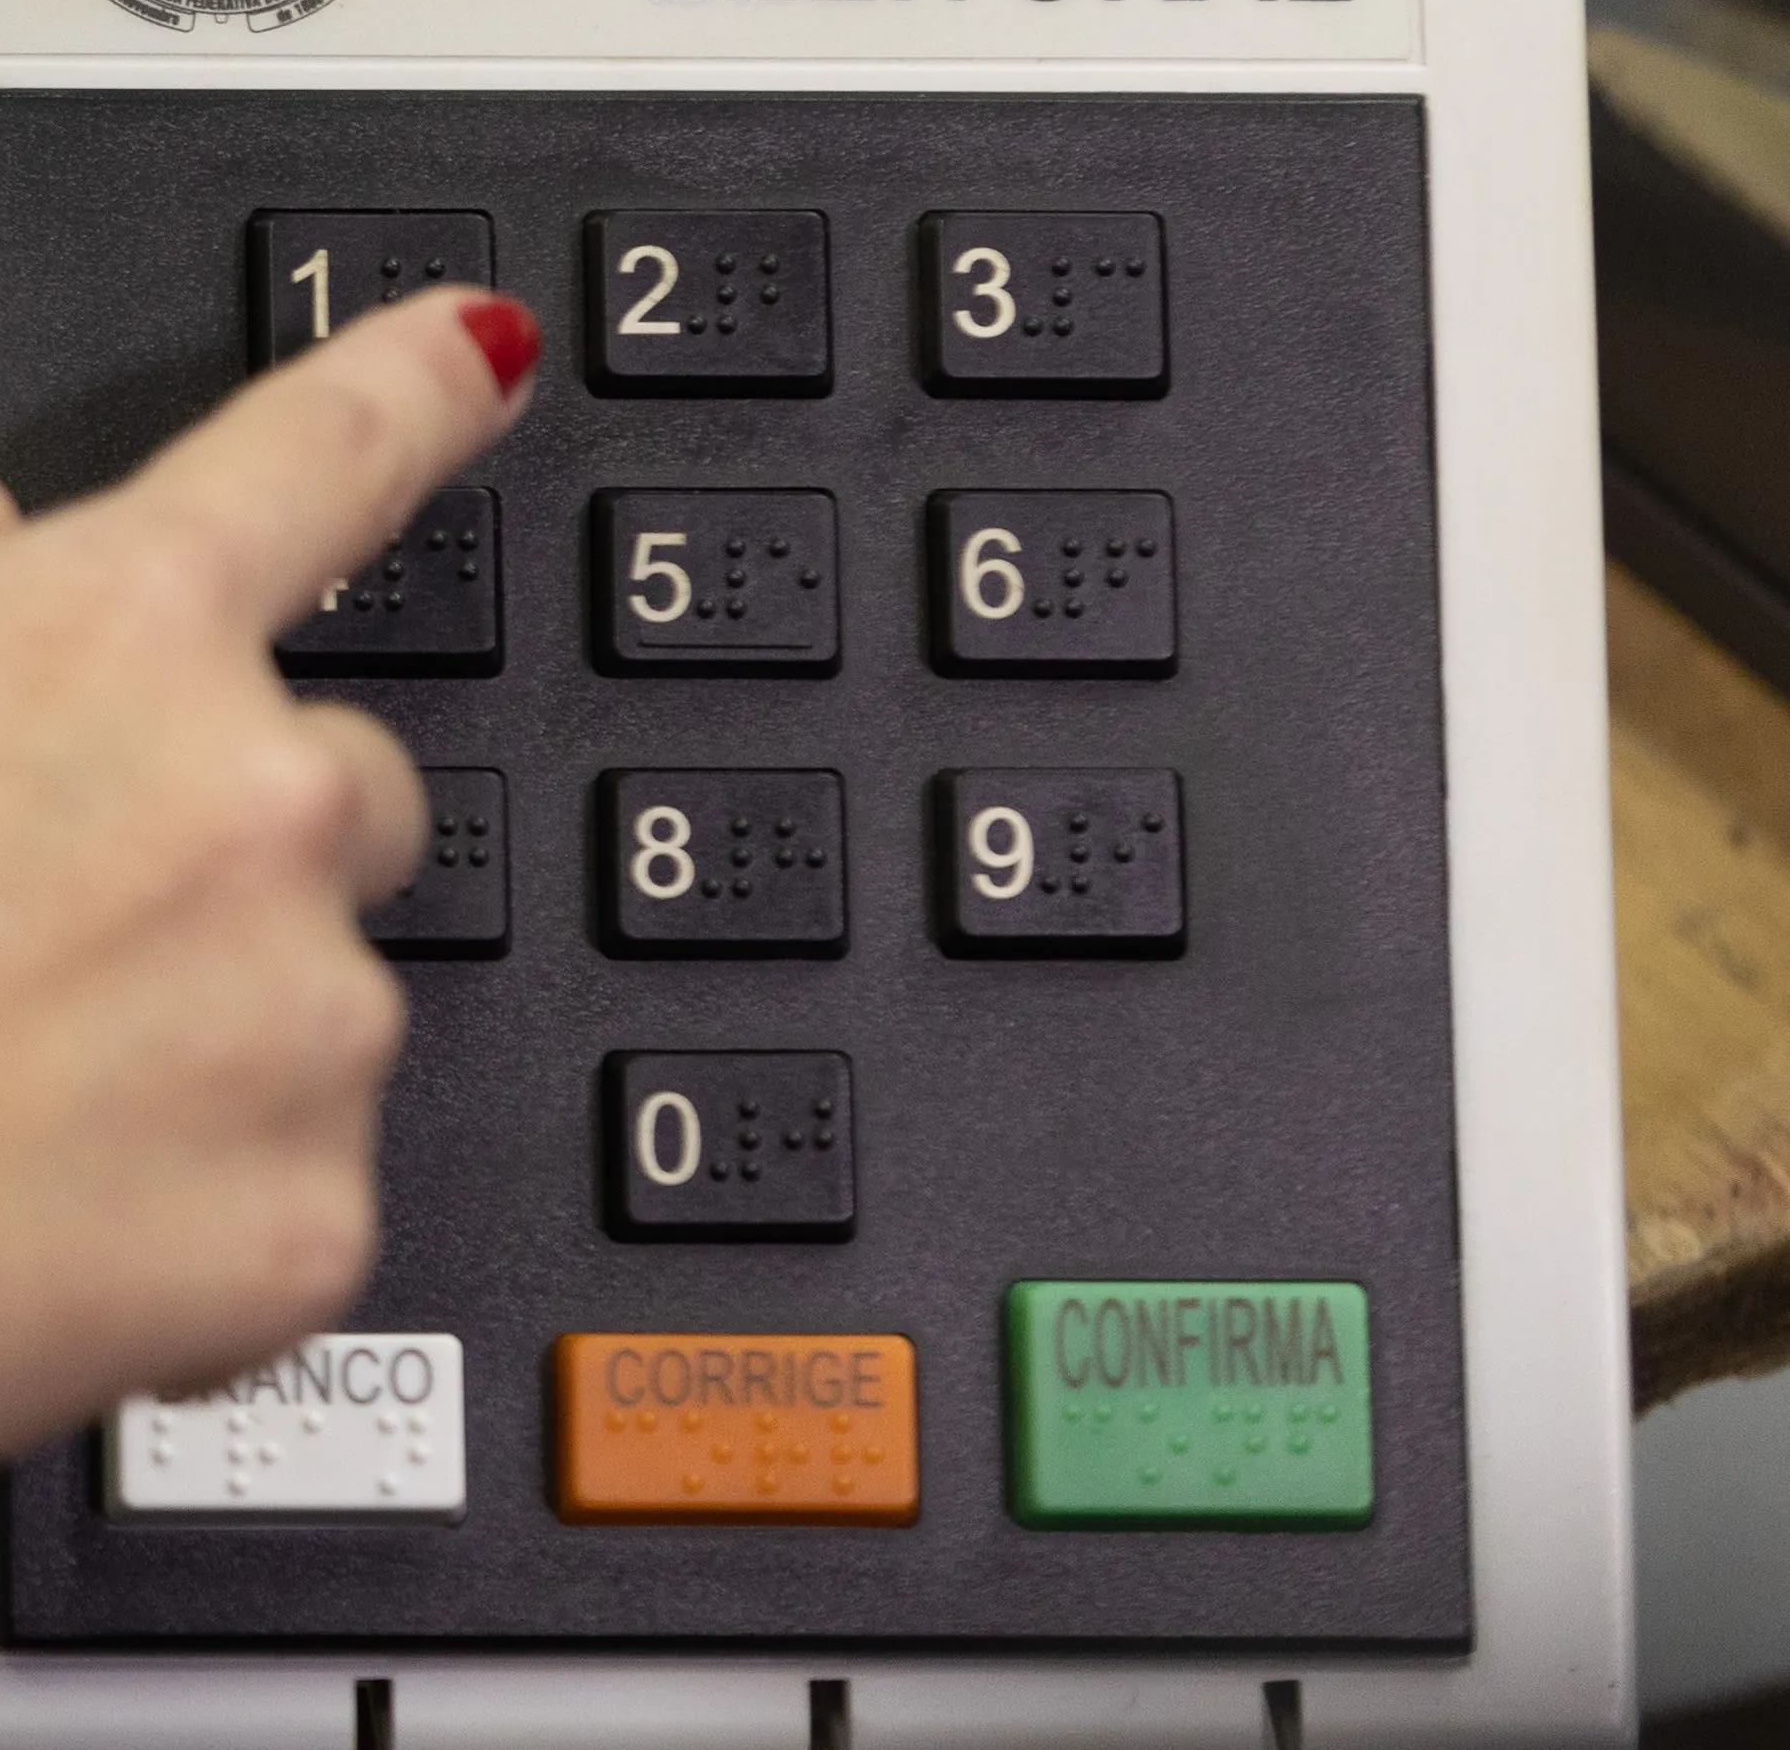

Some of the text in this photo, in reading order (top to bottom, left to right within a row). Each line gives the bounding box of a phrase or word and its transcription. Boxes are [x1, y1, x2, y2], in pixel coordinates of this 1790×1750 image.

[292, 249, 335, 338] 1
[618, 245, 680, 334] 2
[954, 248, 1015, 338] 3
[630, 533, 691, 622] 5
[961, 528, 1024, 619] 6
[632, 806, 695, 898] 8
[970, 807, 1033, 898] 9
[637, 1092, 700, 1185] 0
[600, 1342, 890, 1412] CORRIGE
[1052, 1292, 1348, 1392] CONFIRMA
